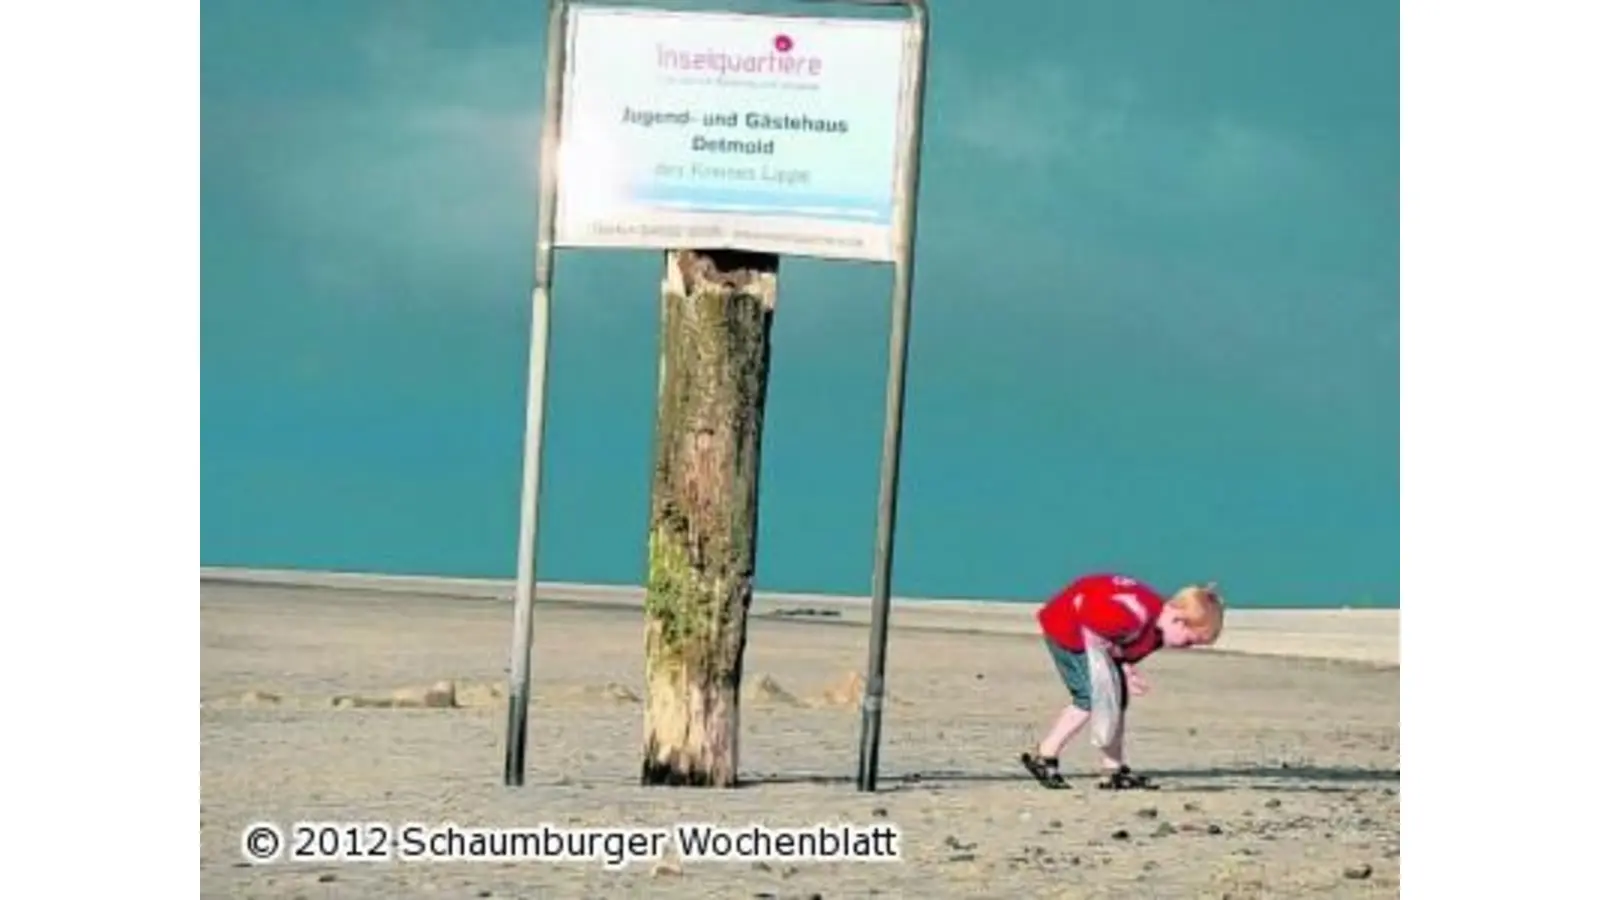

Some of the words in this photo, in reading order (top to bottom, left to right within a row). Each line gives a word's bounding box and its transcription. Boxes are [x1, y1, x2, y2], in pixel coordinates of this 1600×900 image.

[622, 105, 697, 127] Jugend-
[702, 111, 739, 128] und
[744, 112, 849, 134] Gästehaus
[691, 135, 775, 155] Detmold
[761, 164, 811, 185] Lippe
